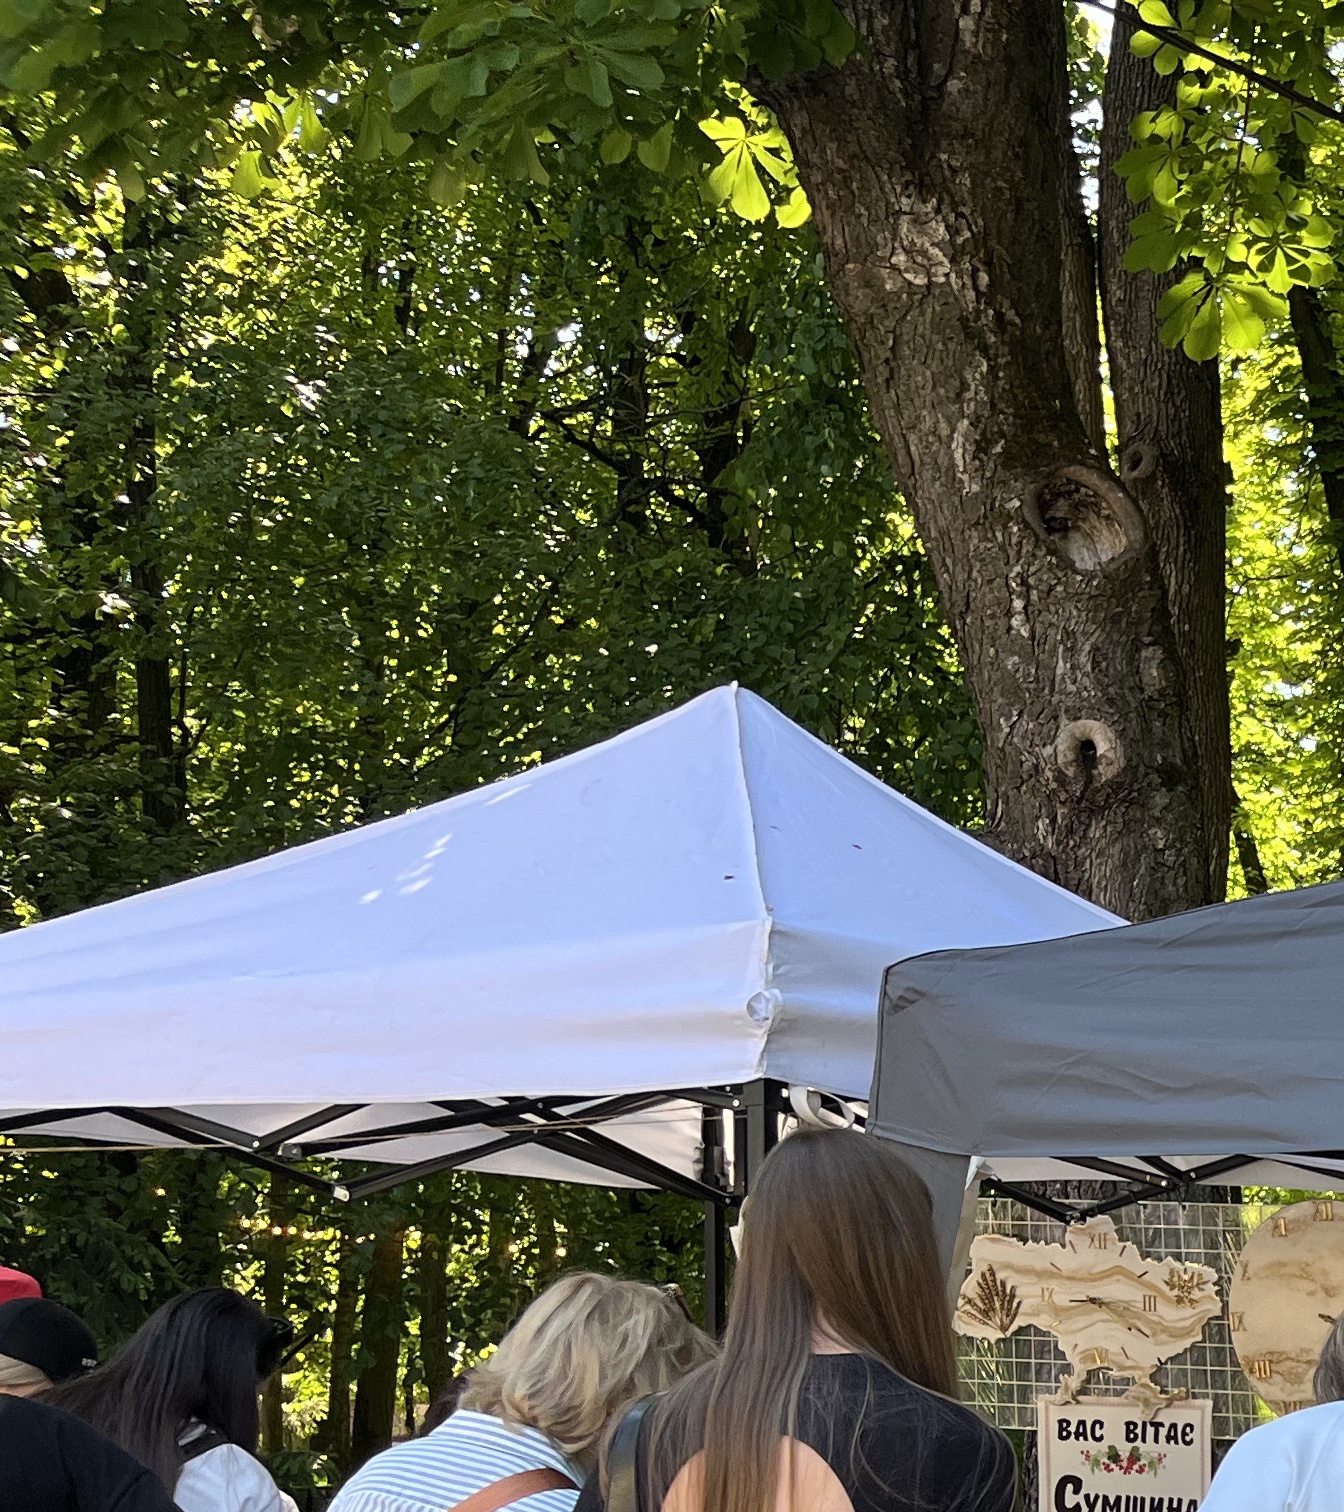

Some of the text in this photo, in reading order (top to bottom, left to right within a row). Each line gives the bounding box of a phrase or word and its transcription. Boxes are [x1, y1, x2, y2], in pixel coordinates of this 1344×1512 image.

[1088, 1232, 1108, 1250] XII
[1142, 1294, 1157, 1312] III
[1057, 1418, 1195, 1446] ВАС ВІТАЄ
